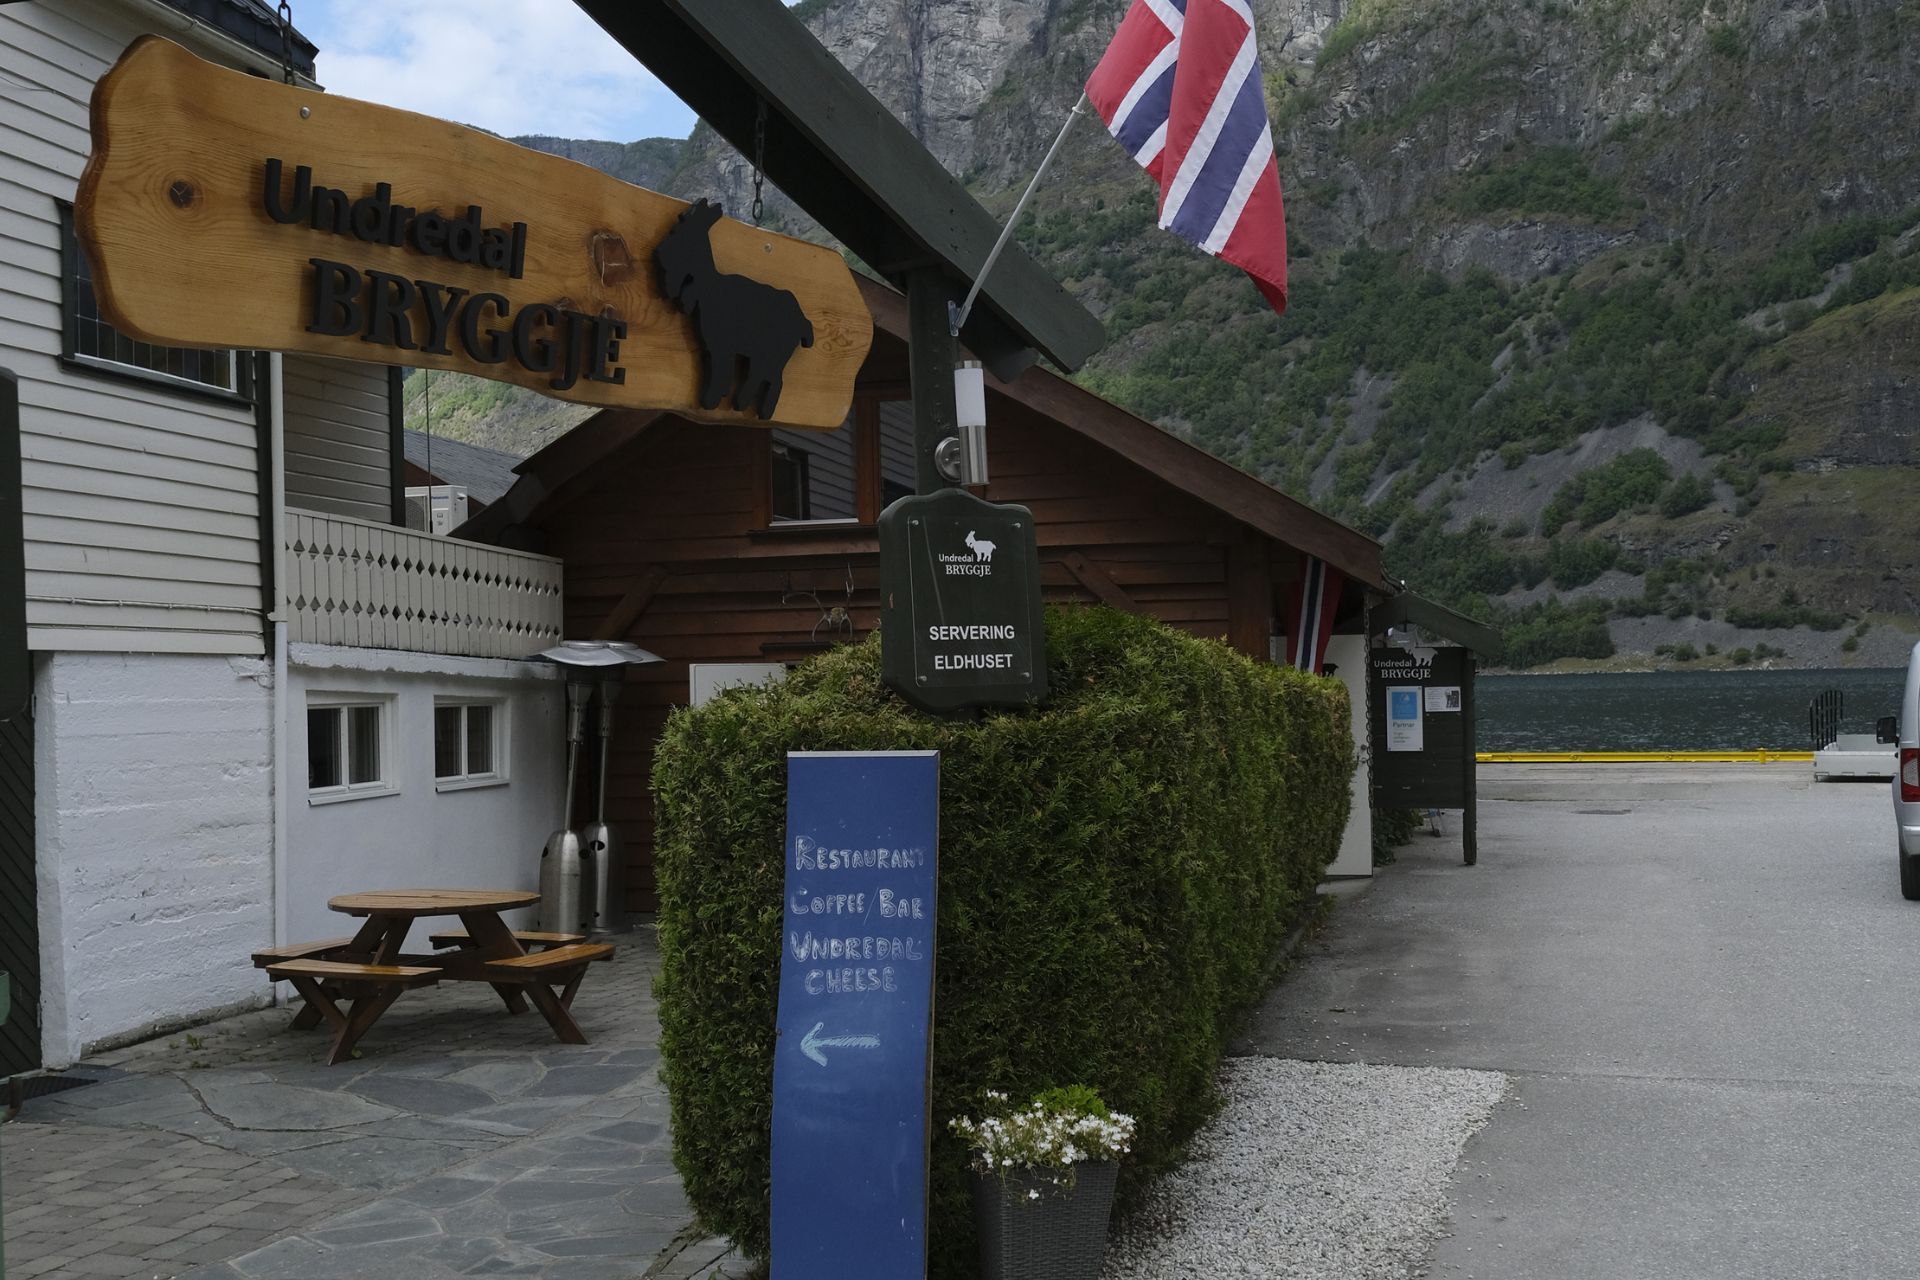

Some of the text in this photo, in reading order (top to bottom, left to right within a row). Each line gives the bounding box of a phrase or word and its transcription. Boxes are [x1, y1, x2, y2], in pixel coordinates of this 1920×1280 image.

[264, 157, 528, 280] Undredal
[305, 257, 627, 391] BRYGGJE
[938, 553, 974, 563] Undredal
[945, 564, 991, 577] BRYGGJE
[929, 625, 1015, 641] SERVERING
[934, 653, 1014, 670] ELDHUSET
[1373, 659, 1413, 668] Undredal
[1381, 668, 1431, 680] BRYGGJE
[795, 835, 925, 871] RESTAURANT
[789, 930, 924, 963] UNDREDAL
[804, 966, 898, 995] CHEESE
